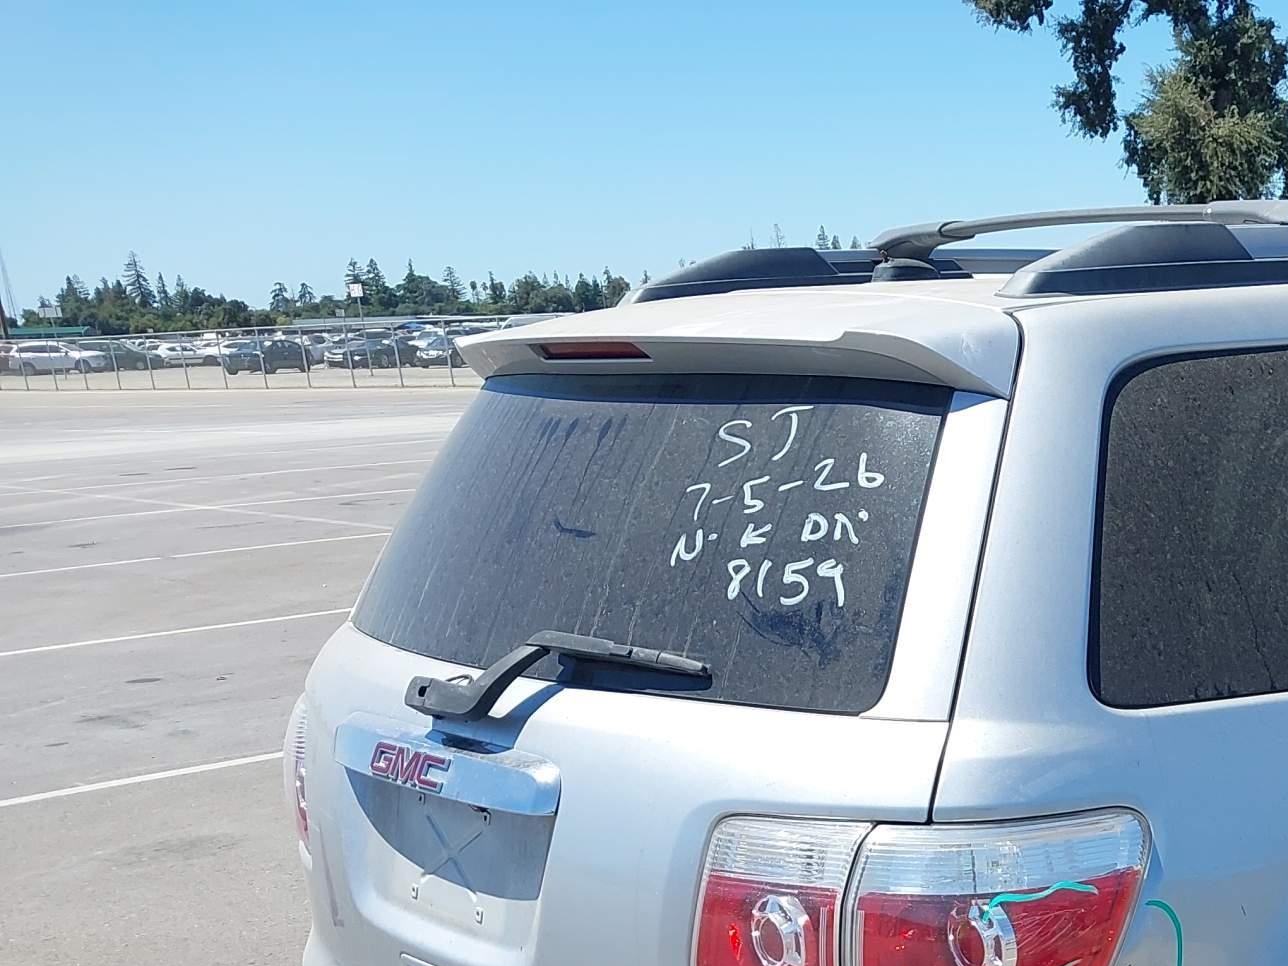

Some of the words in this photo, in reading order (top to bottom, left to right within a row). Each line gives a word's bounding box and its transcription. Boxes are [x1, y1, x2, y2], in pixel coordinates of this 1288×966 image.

[685, 452, 885, 521] 7-5-26
[726, 557, 845, 607] 8159
[369, 740, 452, 794] GMC
